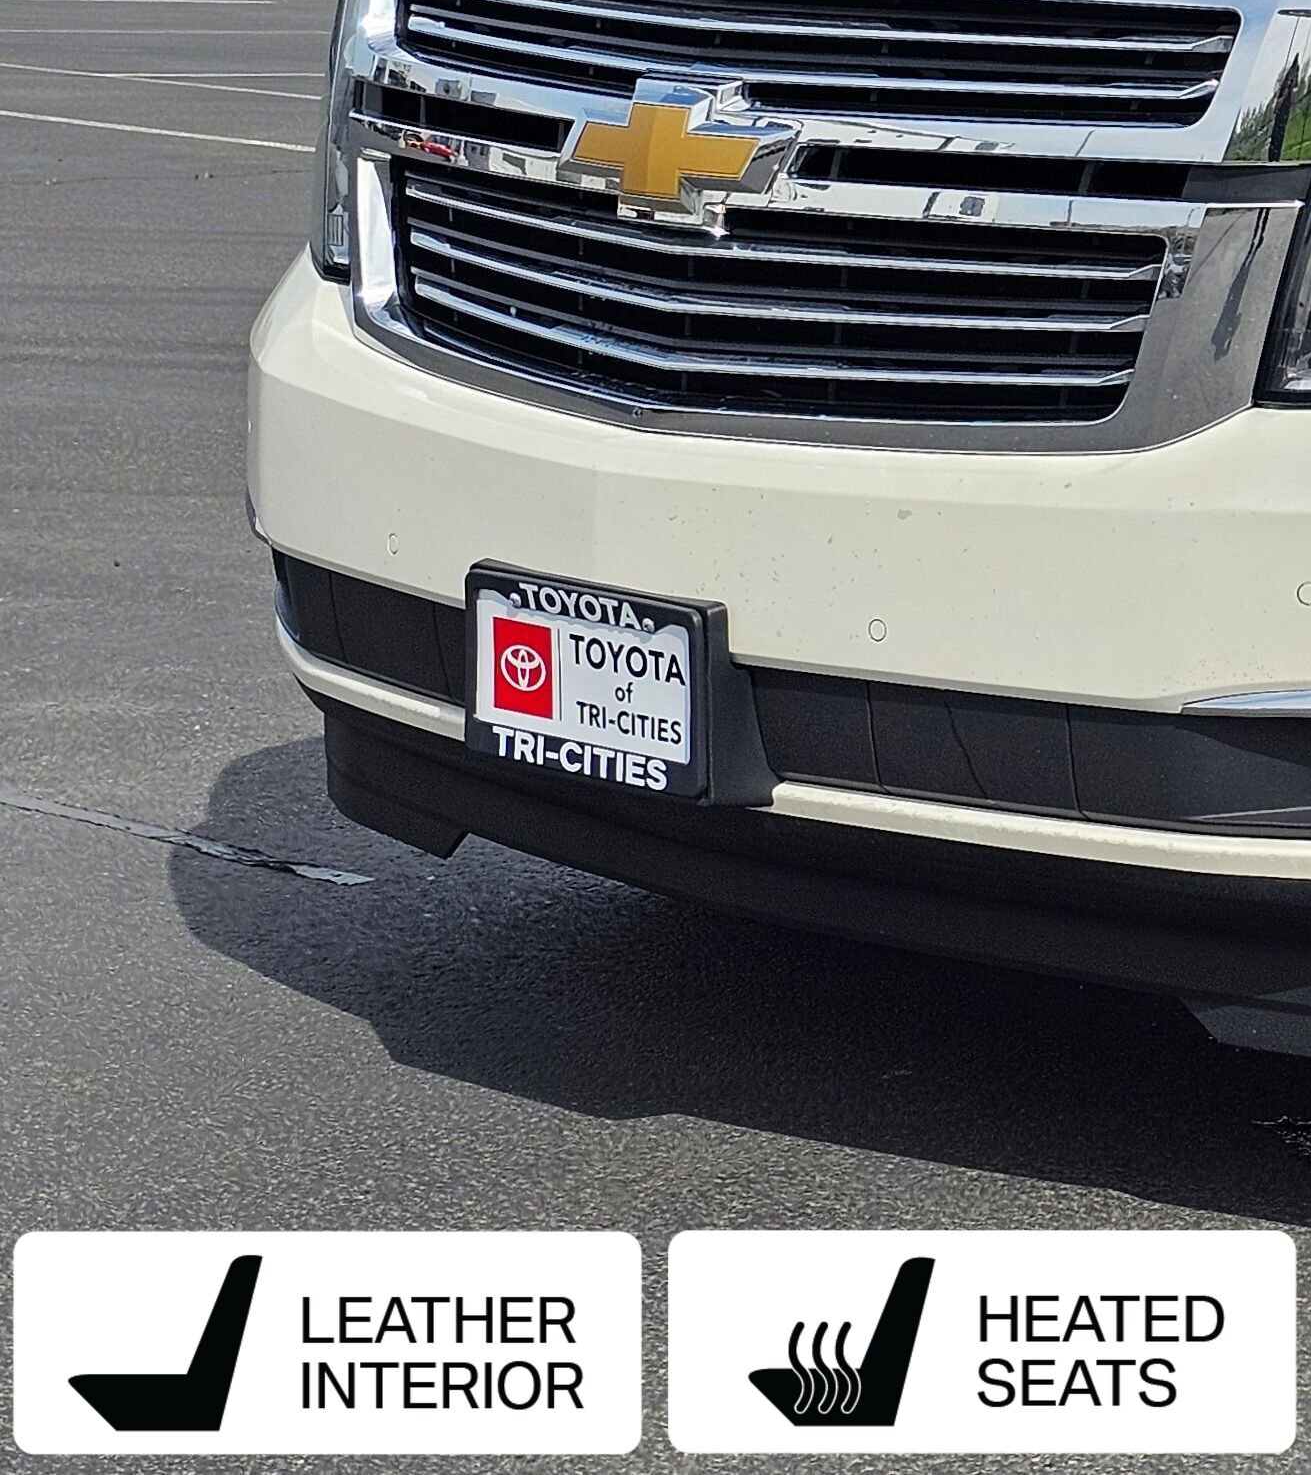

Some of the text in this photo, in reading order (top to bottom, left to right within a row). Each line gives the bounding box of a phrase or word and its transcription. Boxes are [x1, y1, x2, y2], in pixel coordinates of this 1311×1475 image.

[519, 583, 643, 631] TOYOTA
[569, 634, 687, 686] TOYOTA
[614, 682, 634, 705] of
[576, 700, 683, 746] TRI-CITIES
[492, 725, 669, 792] TRI-CITIES
